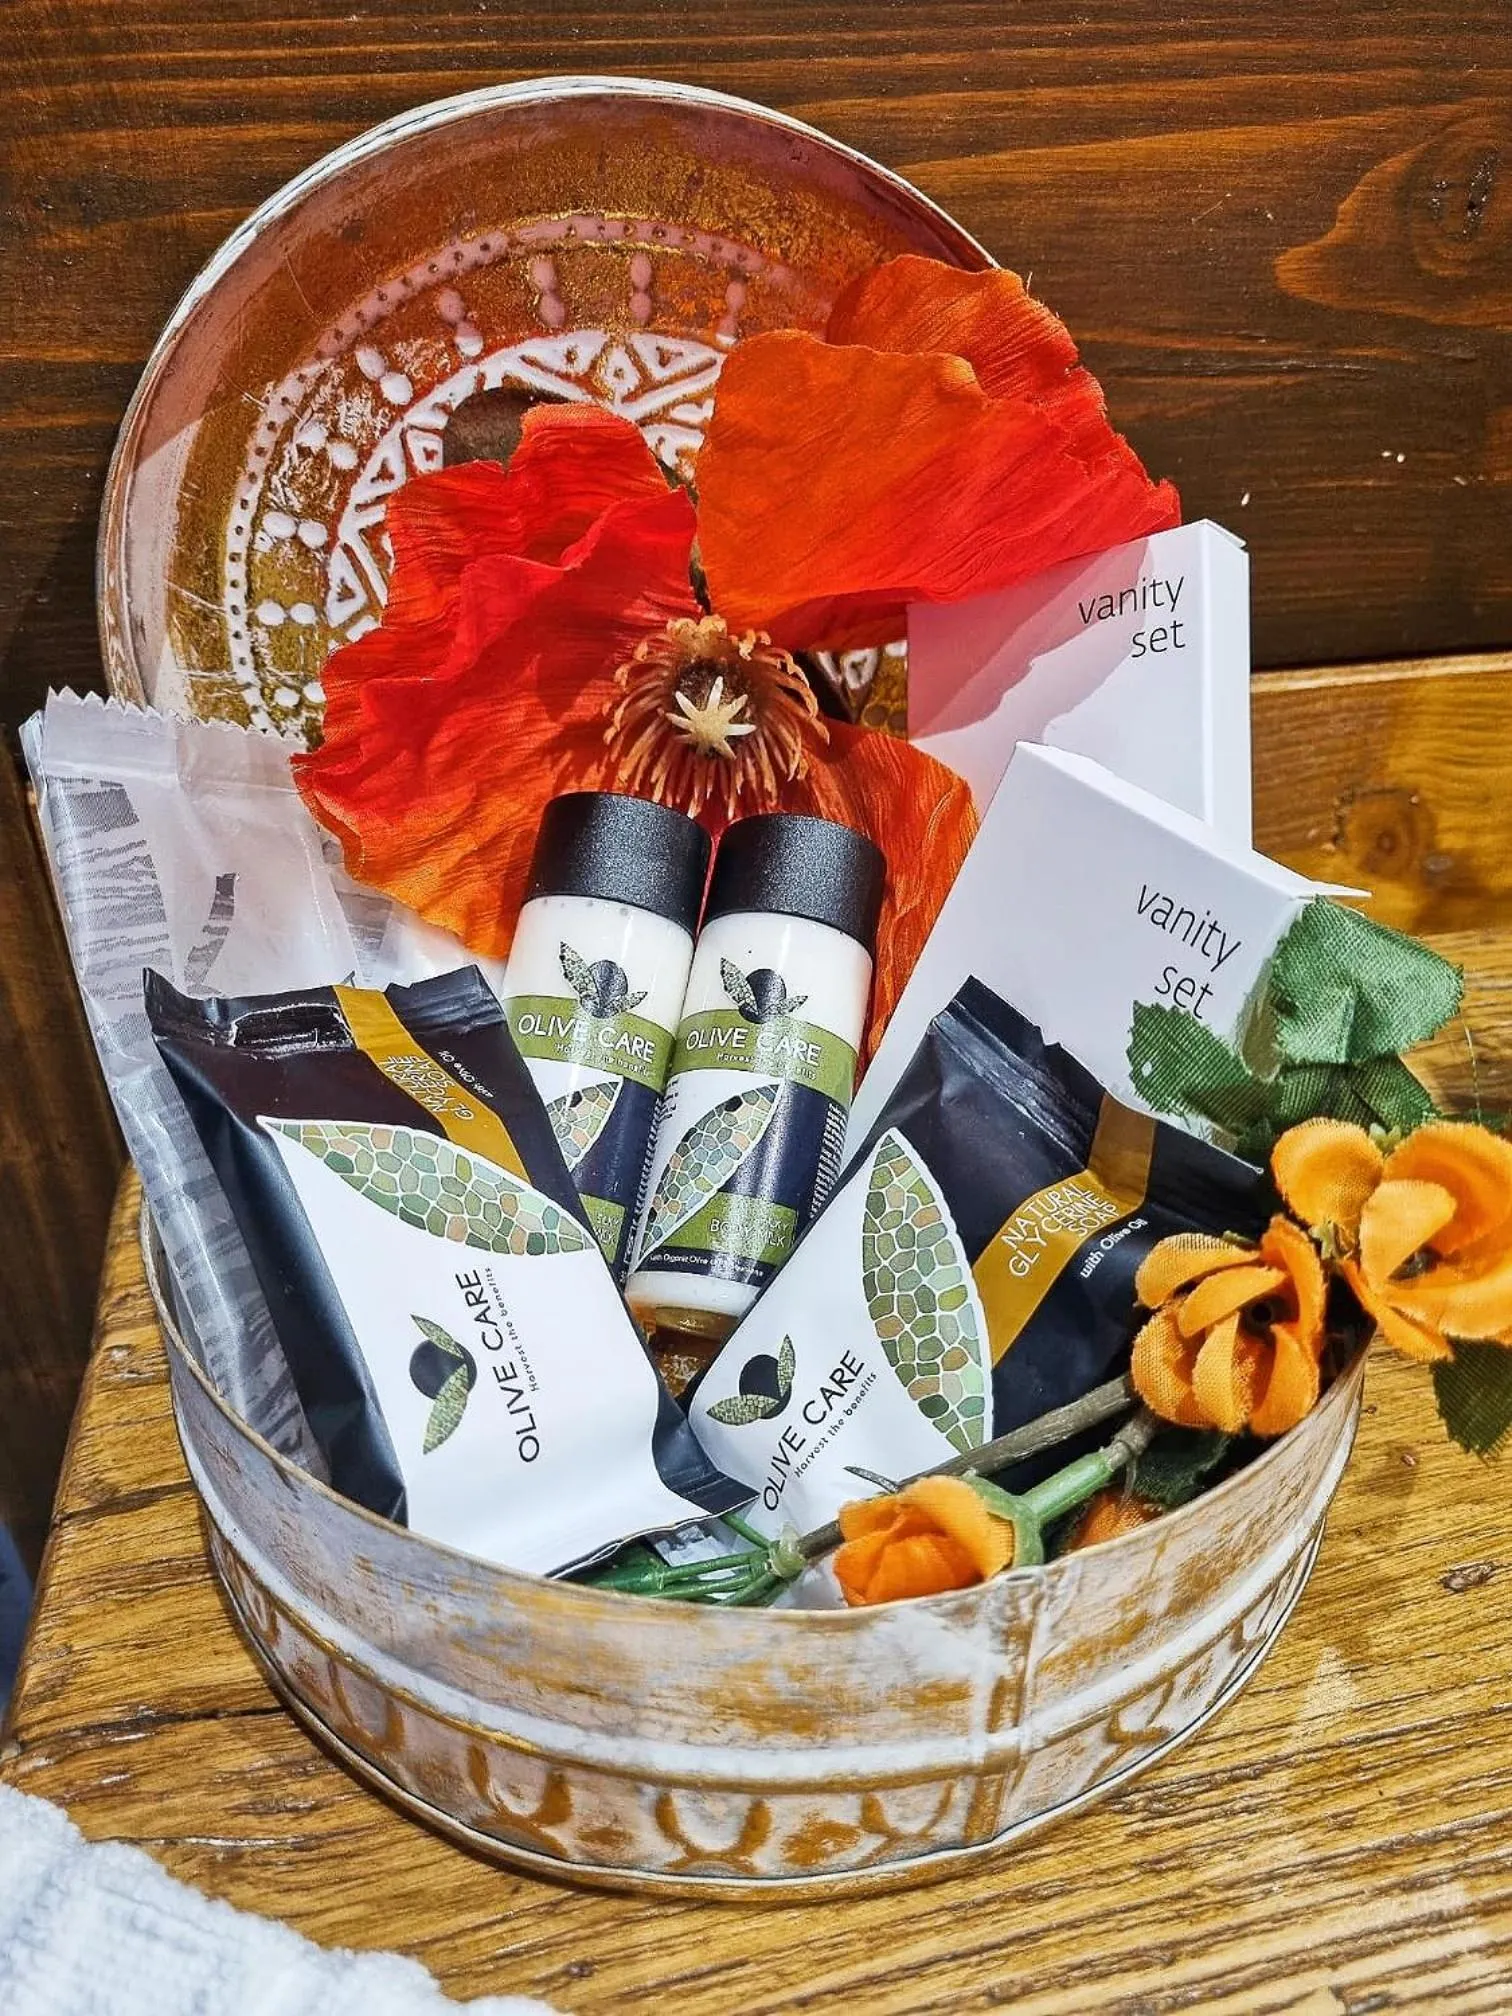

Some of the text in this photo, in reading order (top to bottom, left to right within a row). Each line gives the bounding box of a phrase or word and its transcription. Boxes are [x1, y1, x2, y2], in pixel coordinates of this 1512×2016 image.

[1078, 575, 1185, 625] vanity
[1131, 619, 1186, 658] set
[1137, 884, 1242, 972] vanity
[1154, 966, 1214, 1019] set
[518, 1013, 656, 1063] OLIVE CARE
[686, 1027, 748, 1050] OLIVE
[757, 1031, 822, 1067] CARE
[379, 1056, 449, 1113] NATURAL
[398, 1055, 474, 1120] GLYCERINE
[409, 1055, 456, 1088] SOAP
[1000, 1183, 1088, 1249] NATURAL
[1008, 1190, 1111, 1277] GLYCERINE
[1066, 1204, 1119, 1238] SOAP
[1079, 1249, 1105, 1279] with
[1100, 1226, 1132, 1250] Olive
[484, 1267, 540, 1392] Harvest the benefits
[455, 1268, 540, 1463] OLIVE CARE
[762, 1349, 865, 1512] OLIVE CARE
[794, 1372, 878, 1478] Harvest the benefits
